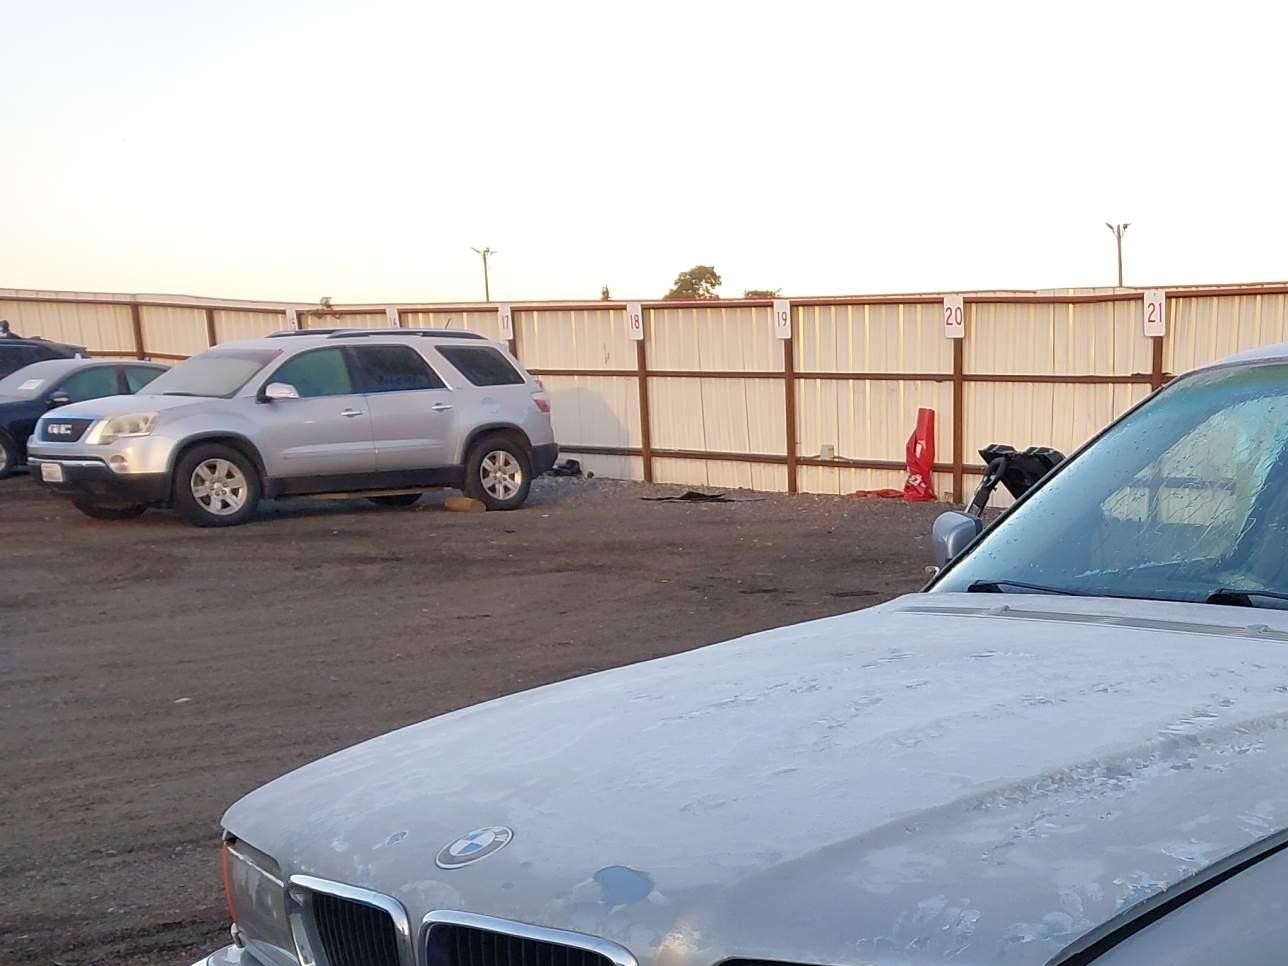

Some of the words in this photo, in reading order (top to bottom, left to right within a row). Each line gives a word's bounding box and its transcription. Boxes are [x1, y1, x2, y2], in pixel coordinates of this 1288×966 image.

[777, 311, 788, 327] 19
[945, 306, 963, 326] 20
[1147, 301, 1162, 323] 21
[501, 314, 509, 329] 17
[630, 313, 640, 330] 18
